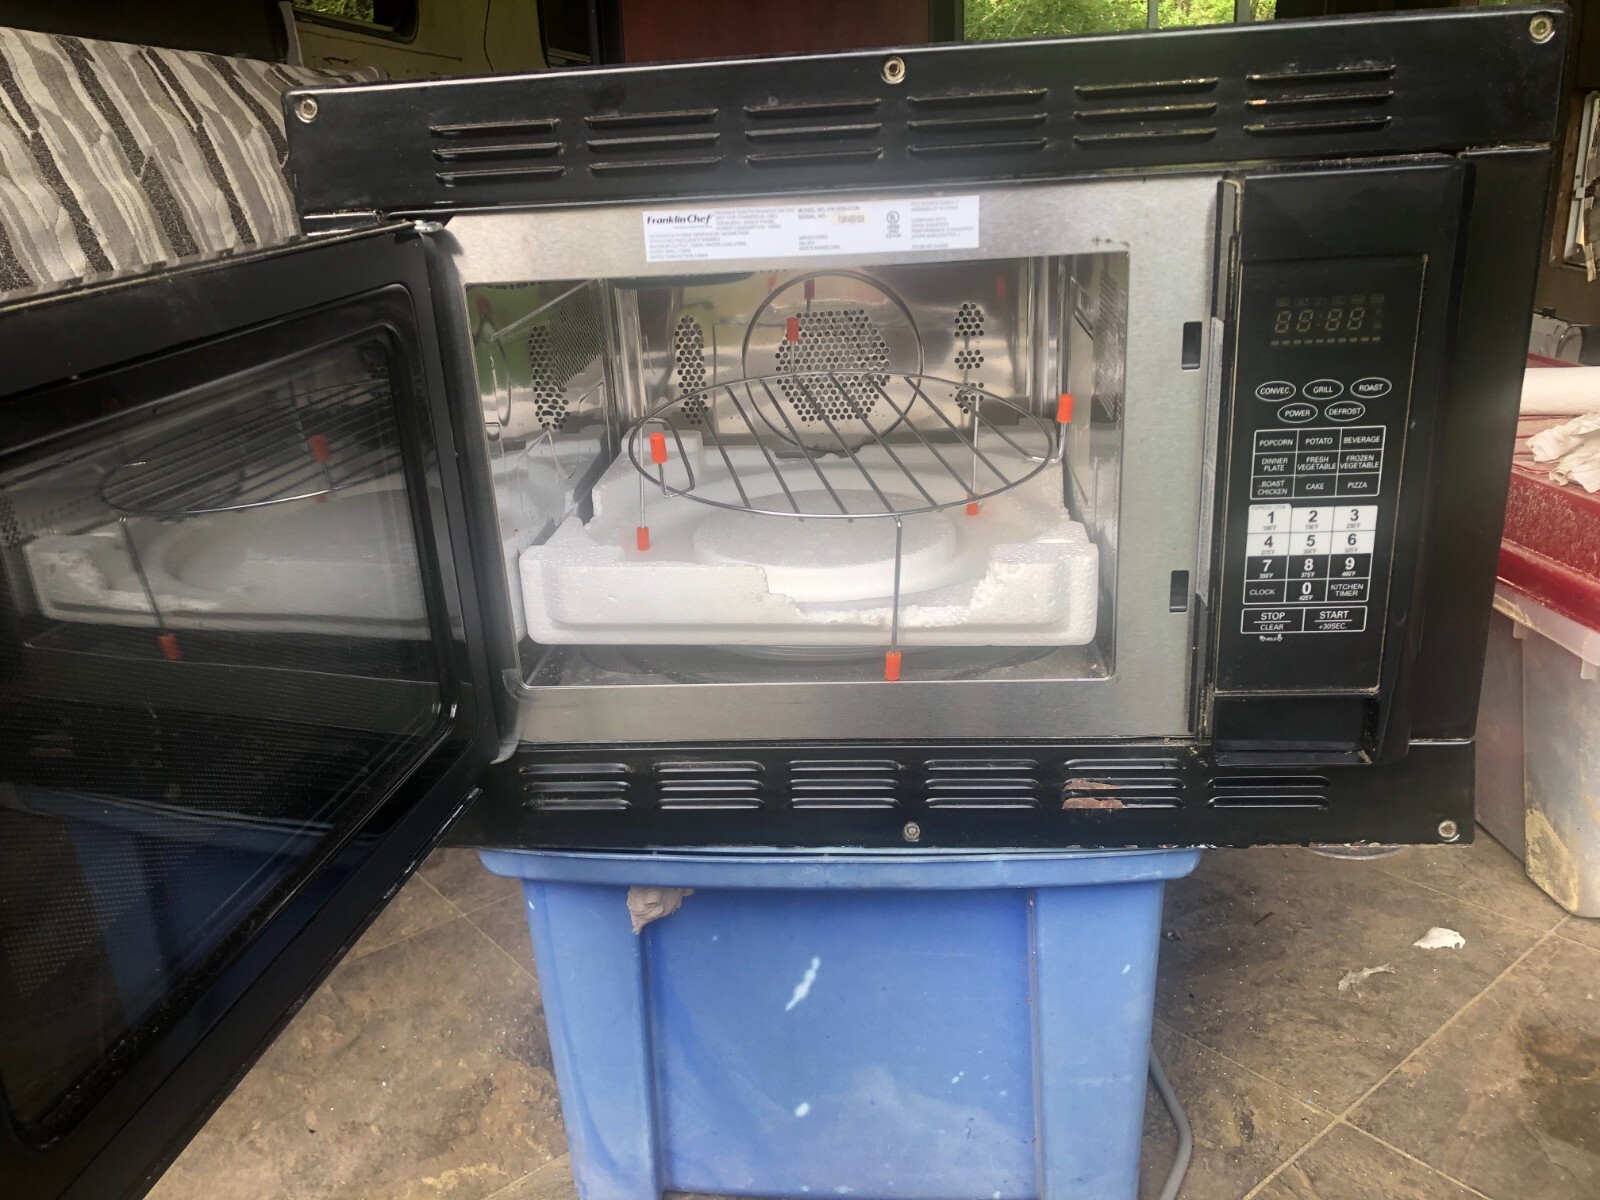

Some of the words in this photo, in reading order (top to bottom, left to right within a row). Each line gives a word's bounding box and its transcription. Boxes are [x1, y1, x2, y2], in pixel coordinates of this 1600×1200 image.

[1313, 386, 1333, 394] GRILL
[1358, 383, 1384, 392] ROAST
[1284, 409, 1311, 417] POWER
[1328, 407, 1361, 416] DEFROST
[1305, 437, 1333, 445] POTATO
[1343, 435, 1381, 444] BEVERAGE
[1261, 457, 1288, 465] DINNER
[1346, 454, 1375, 462] FROZEN
[1264, 464, 1285, 472] PLATE
[1297, 462, 1337, 471] VEGETABLE
[1340, 461, 1379, 469] VEGETABLE
[1347, 481, 1368, 489] PIZZA
[1257, 488, 1288, 496] CHICKEN
[1267, 511, 1275, 524] 1
[1308, 510, 1318, 523] 2
[1350, 509, 1359, 522] 3
[1264, 535, 1273, 548] 4
[1306, 535, 1315, 547] 5
[1348, 533, 1357, 546] 6
[1262, 559, 1272, 572] 7
[1303, 558, 1314, 572] 8
[1344, 557, 1355, 570] 9
[1301, 582, 1312, 595] 0
[1330, 583, 1364, 591] KITCHEN
[1249, 588, 1276, 596] CLOCK
[1261, 612, 1286, 621] STOP
[1319, 610, 1349, 619] START
